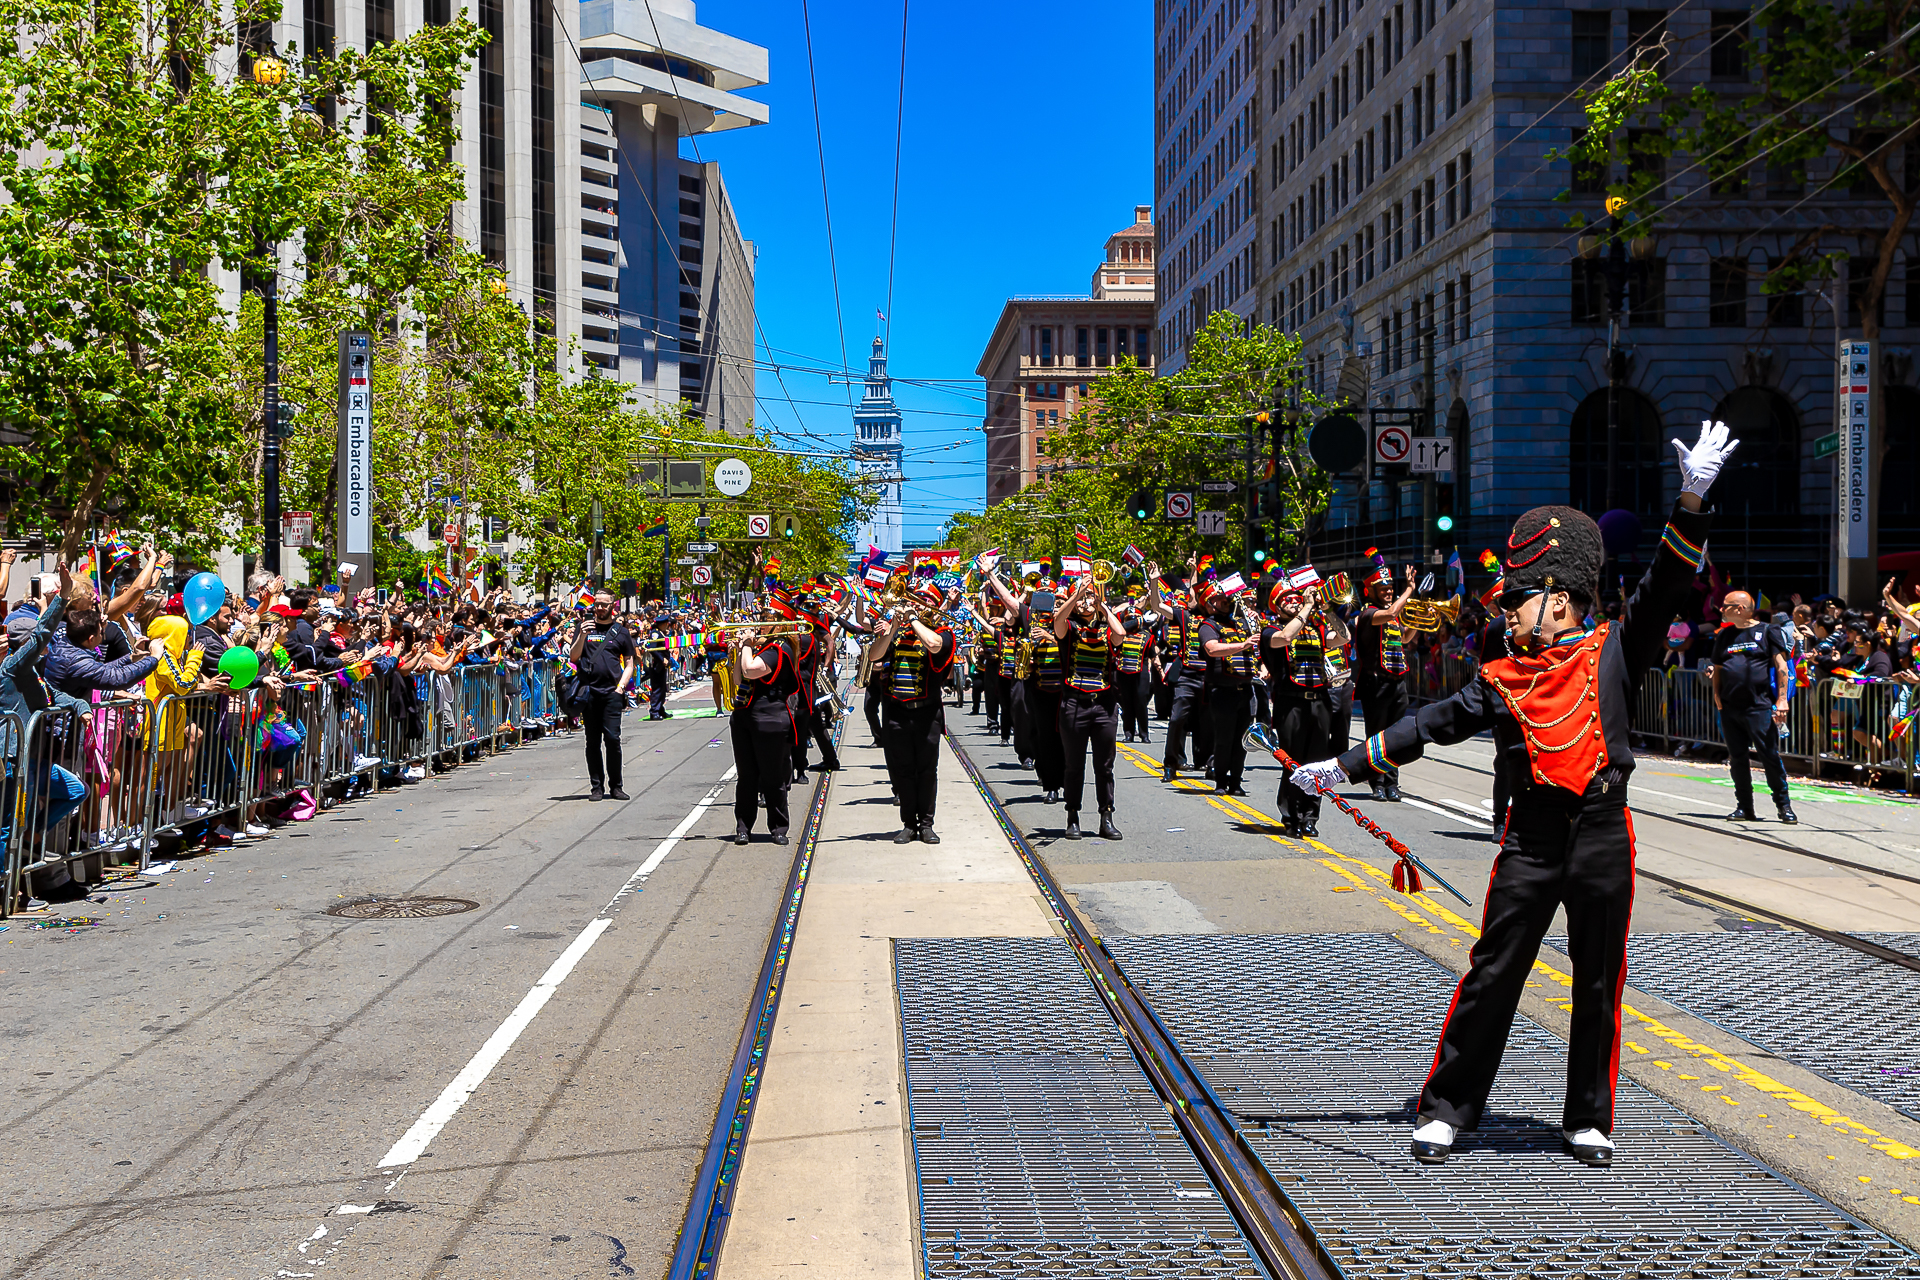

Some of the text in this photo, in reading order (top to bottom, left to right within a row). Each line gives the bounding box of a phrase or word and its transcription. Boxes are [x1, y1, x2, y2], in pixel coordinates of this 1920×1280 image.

[350, 416, 365, 517] Embarcadero
[1851, 423, 1866, 523] Embarcadero
[283, 518, 292, 526] NO
